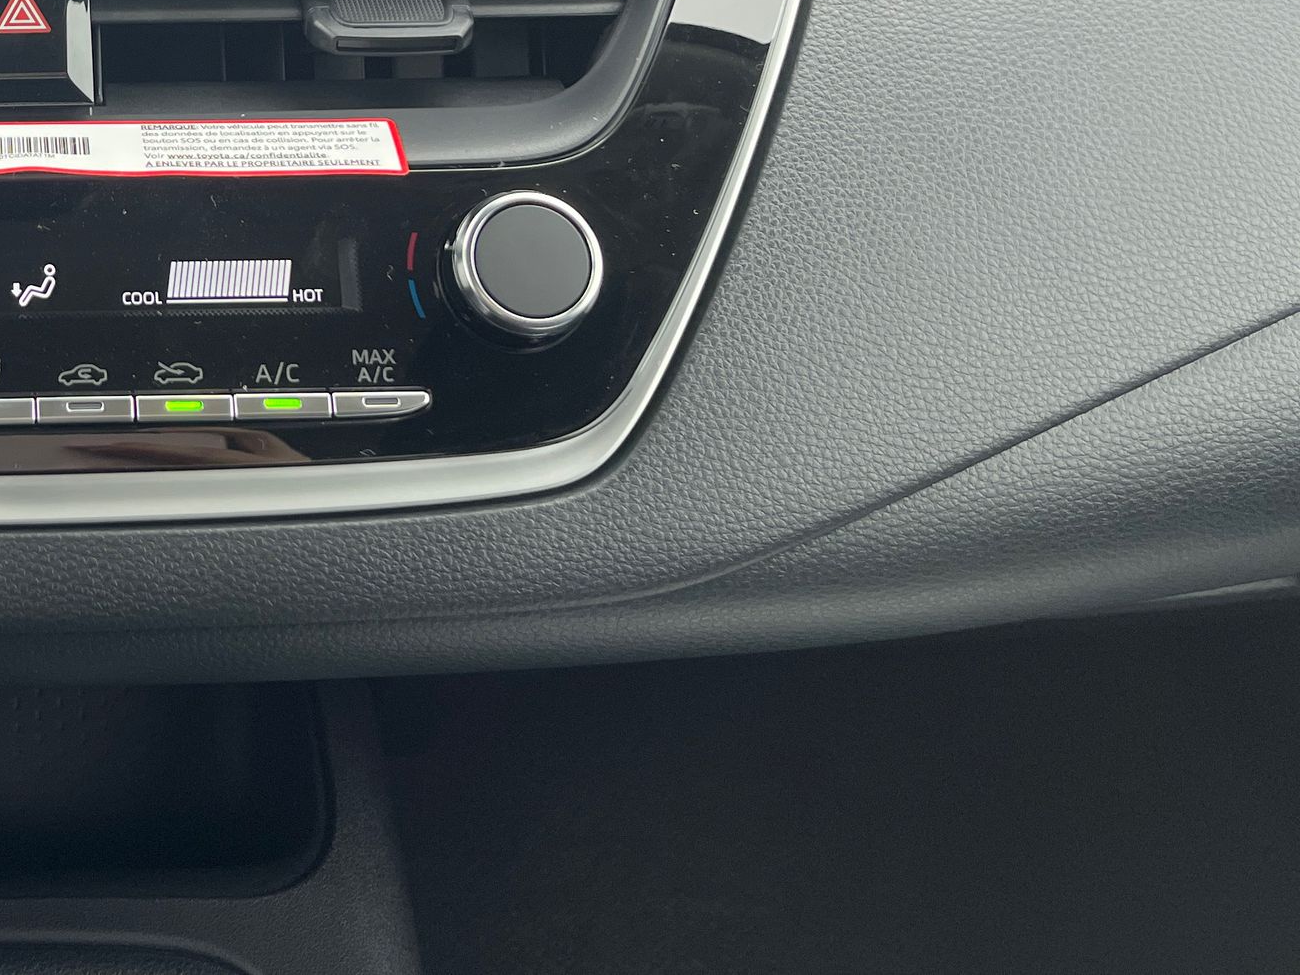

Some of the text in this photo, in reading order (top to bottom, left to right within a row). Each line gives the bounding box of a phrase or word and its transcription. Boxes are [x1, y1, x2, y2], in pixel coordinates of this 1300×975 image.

[122, 288, 324, 306] COOL HOT
[352, 348, 397, 365] MAX
[255, 361, 300, 386] A/C
[357, 366, 394, 384] A/C
